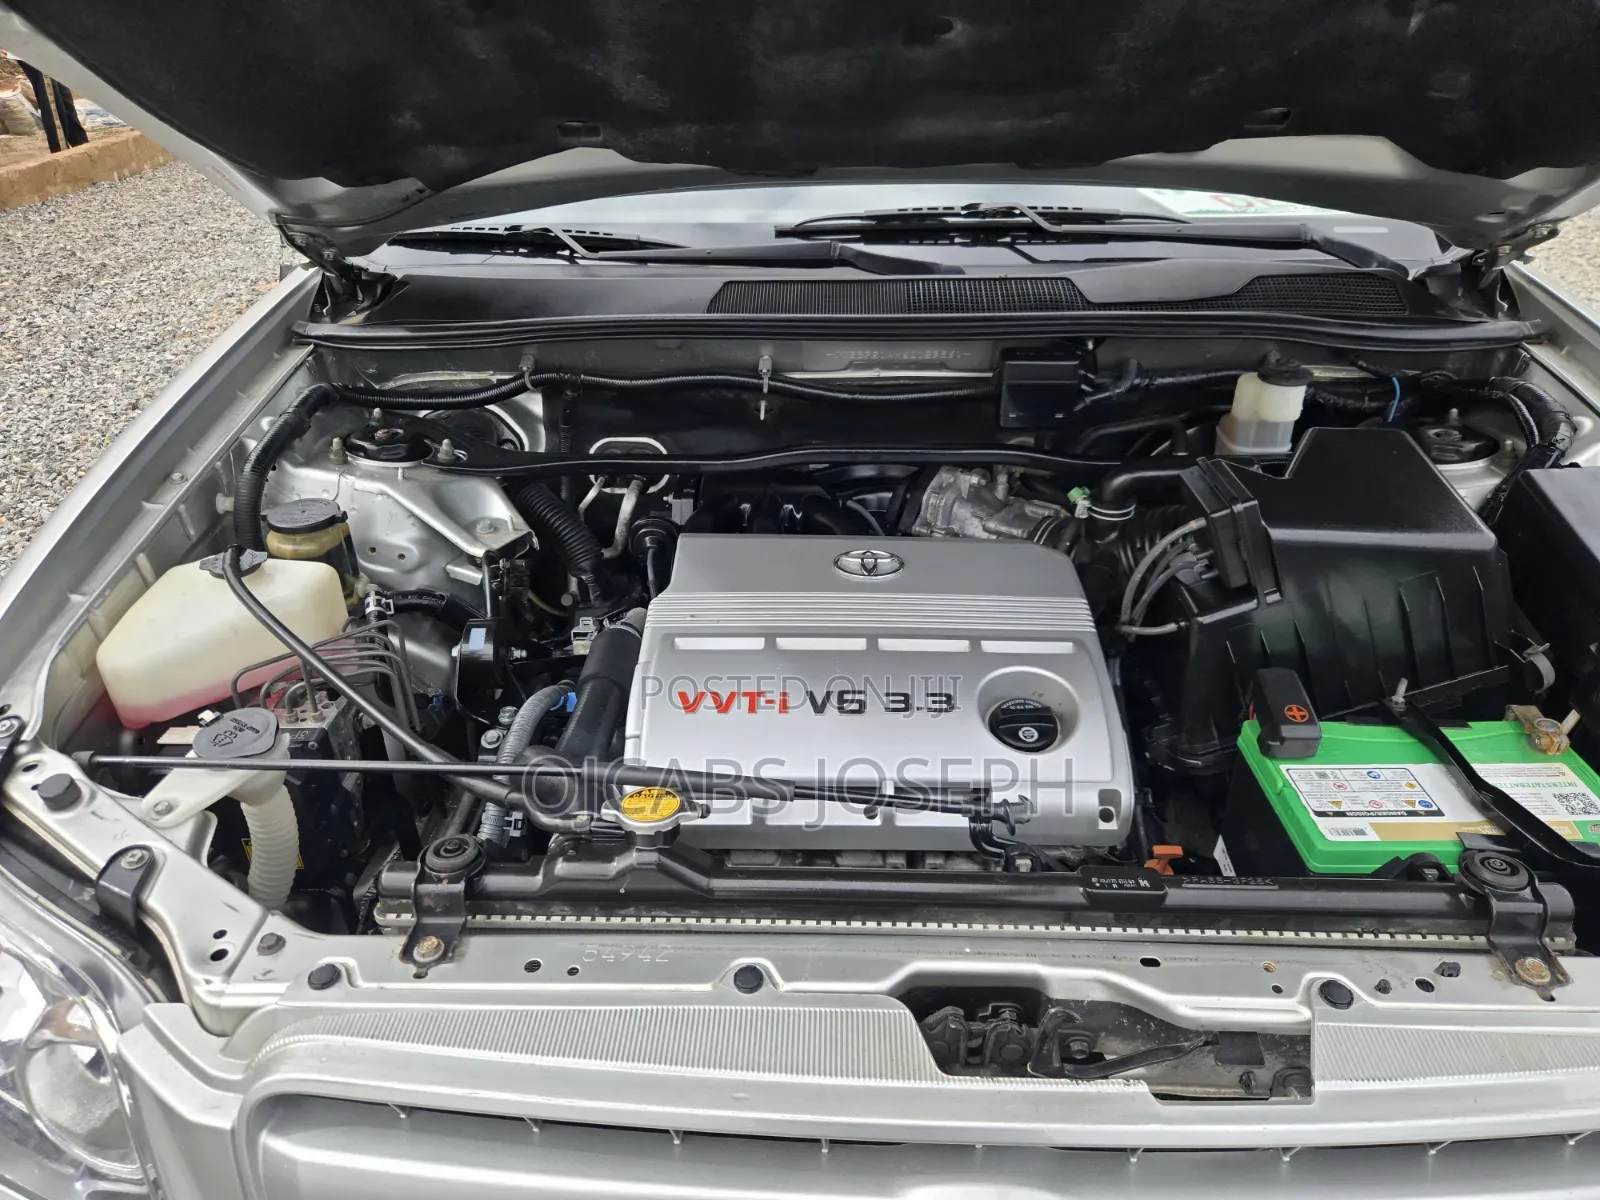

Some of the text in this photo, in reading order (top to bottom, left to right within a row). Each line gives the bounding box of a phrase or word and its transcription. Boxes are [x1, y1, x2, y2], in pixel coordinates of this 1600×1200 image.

[677, 690, 955, 714] VVT-i V6 3.3
[582, 944, 670, 962] 54942
